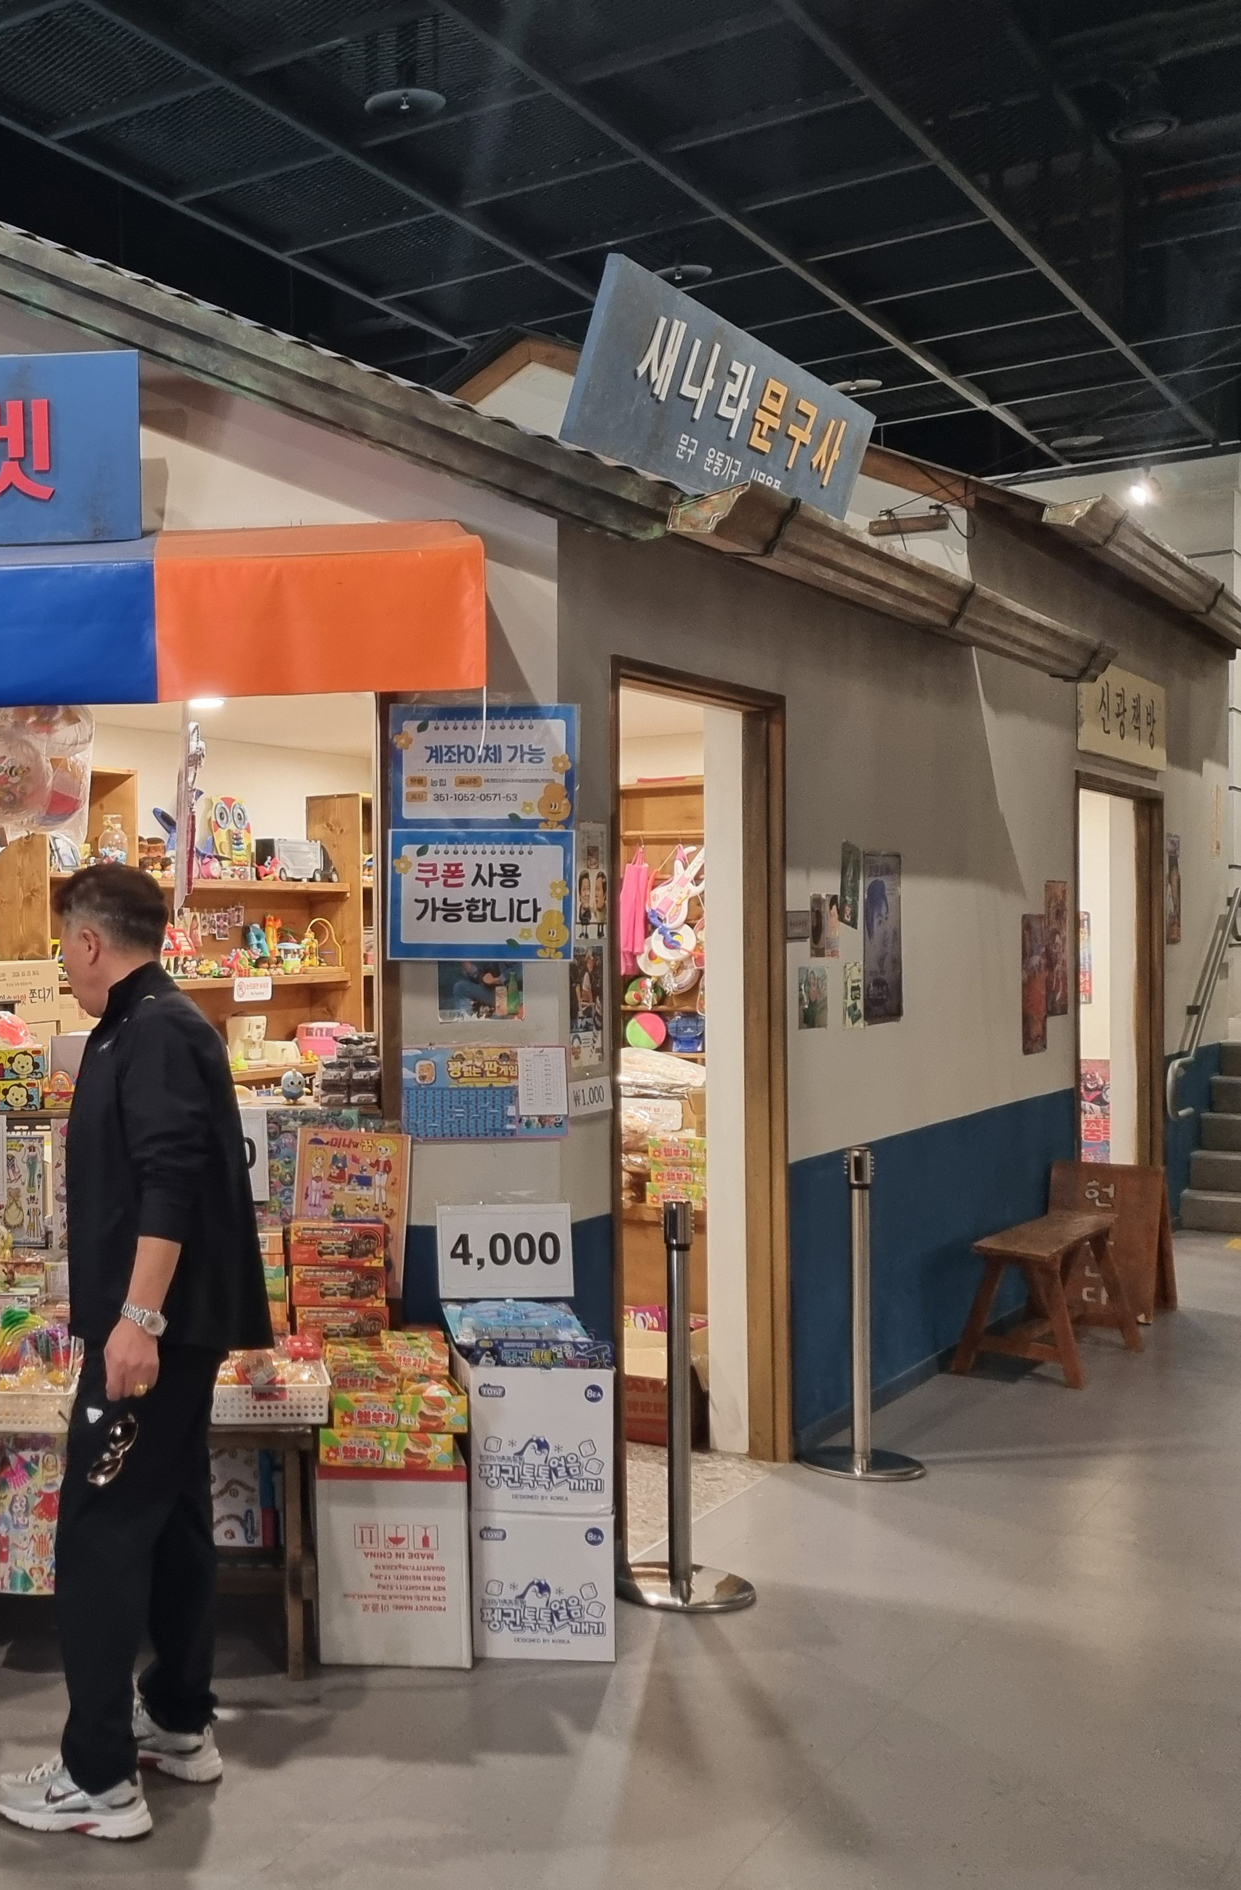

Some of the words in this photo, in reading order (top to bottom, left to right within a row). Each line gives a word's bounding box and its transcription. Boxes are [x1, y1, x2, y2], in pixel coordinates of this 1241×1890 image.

[675, 433, 699, 463] 문구
[703, 447, 743, 483] 운동기구
[1098, 680, 1157, 750] 신광책방
[424, 744, 503, 765] 계좌이체
[506, 743, 547, 764] 가능
[433, 793, 518, 802] 351-1052-0571-53
[415, 861, 466, 889] 쿠폰
[470, 862, 522, 889] 사용
[414, 897, 542, 924] 가능합니다
[450, 1231, 561, 1271] 4,000
[363, 1551, 392, 1559] CHINA
[395, 1552, 405, 1560] IN
[408, 1552, 434, 1560] MADE
